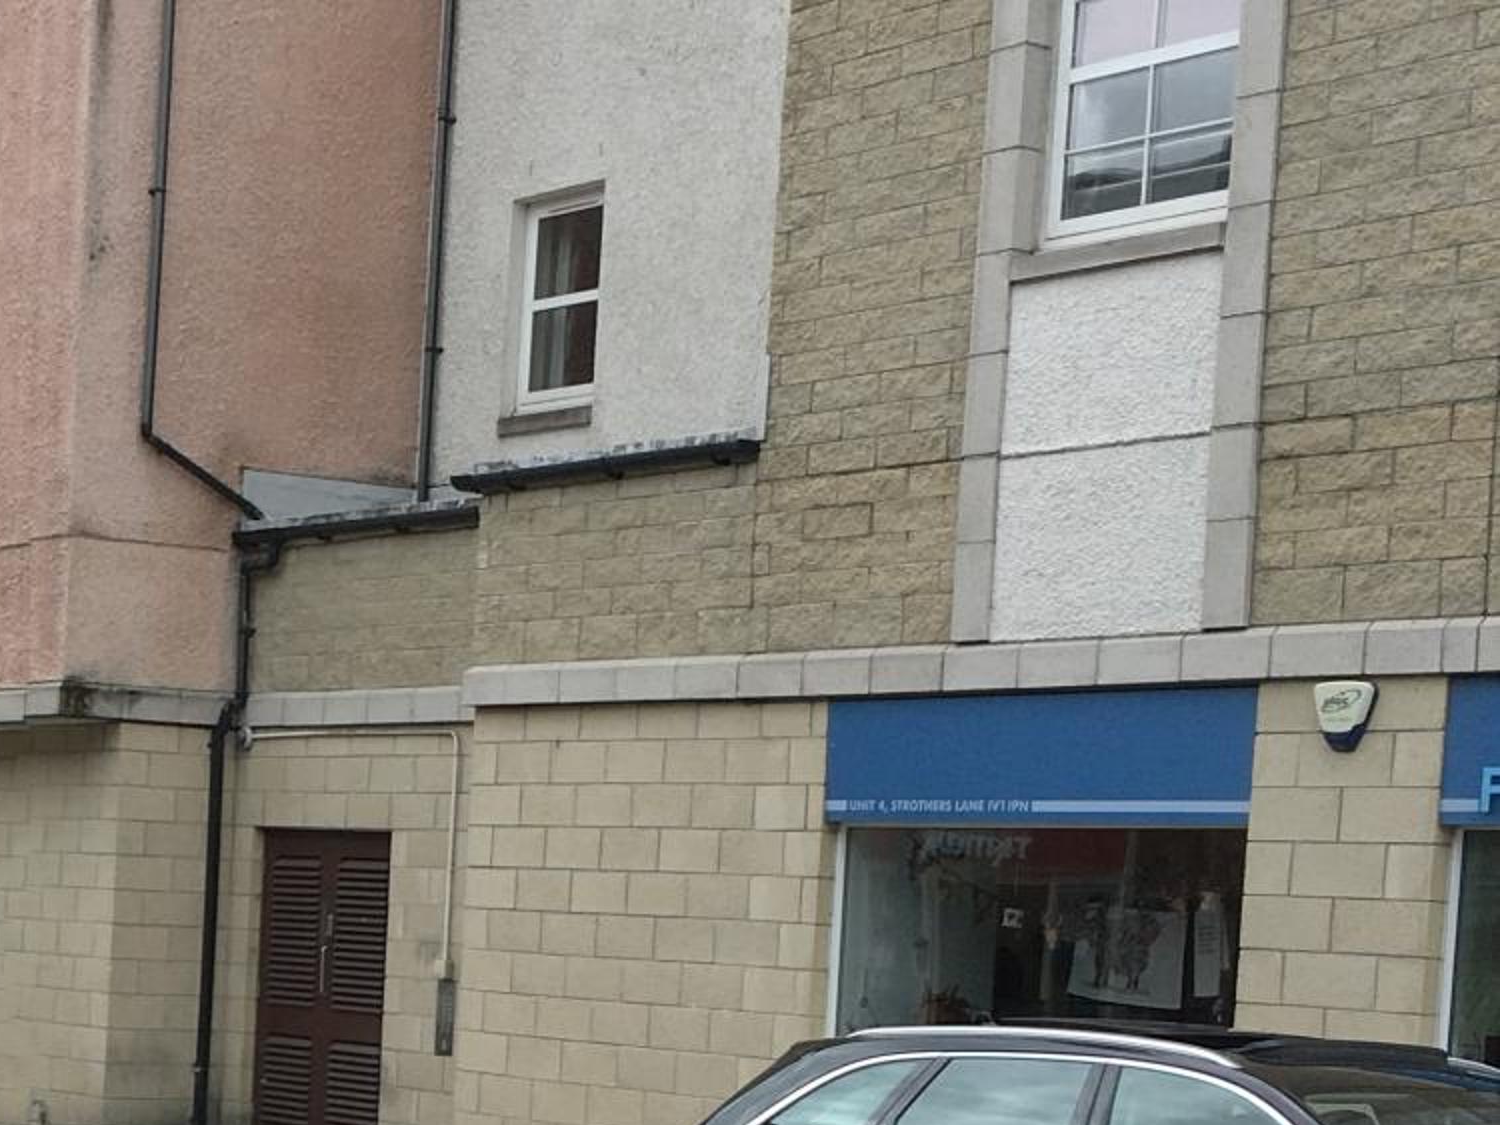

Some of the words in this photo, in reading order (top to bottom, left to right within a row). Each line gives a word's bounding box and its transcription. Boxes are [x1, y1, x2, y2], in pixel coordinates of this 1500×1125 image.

[849, 800, 876, 812] UNIT
[890, 800, 952, 812] STROTHERS
[954, 800, 985, 813] LANE
